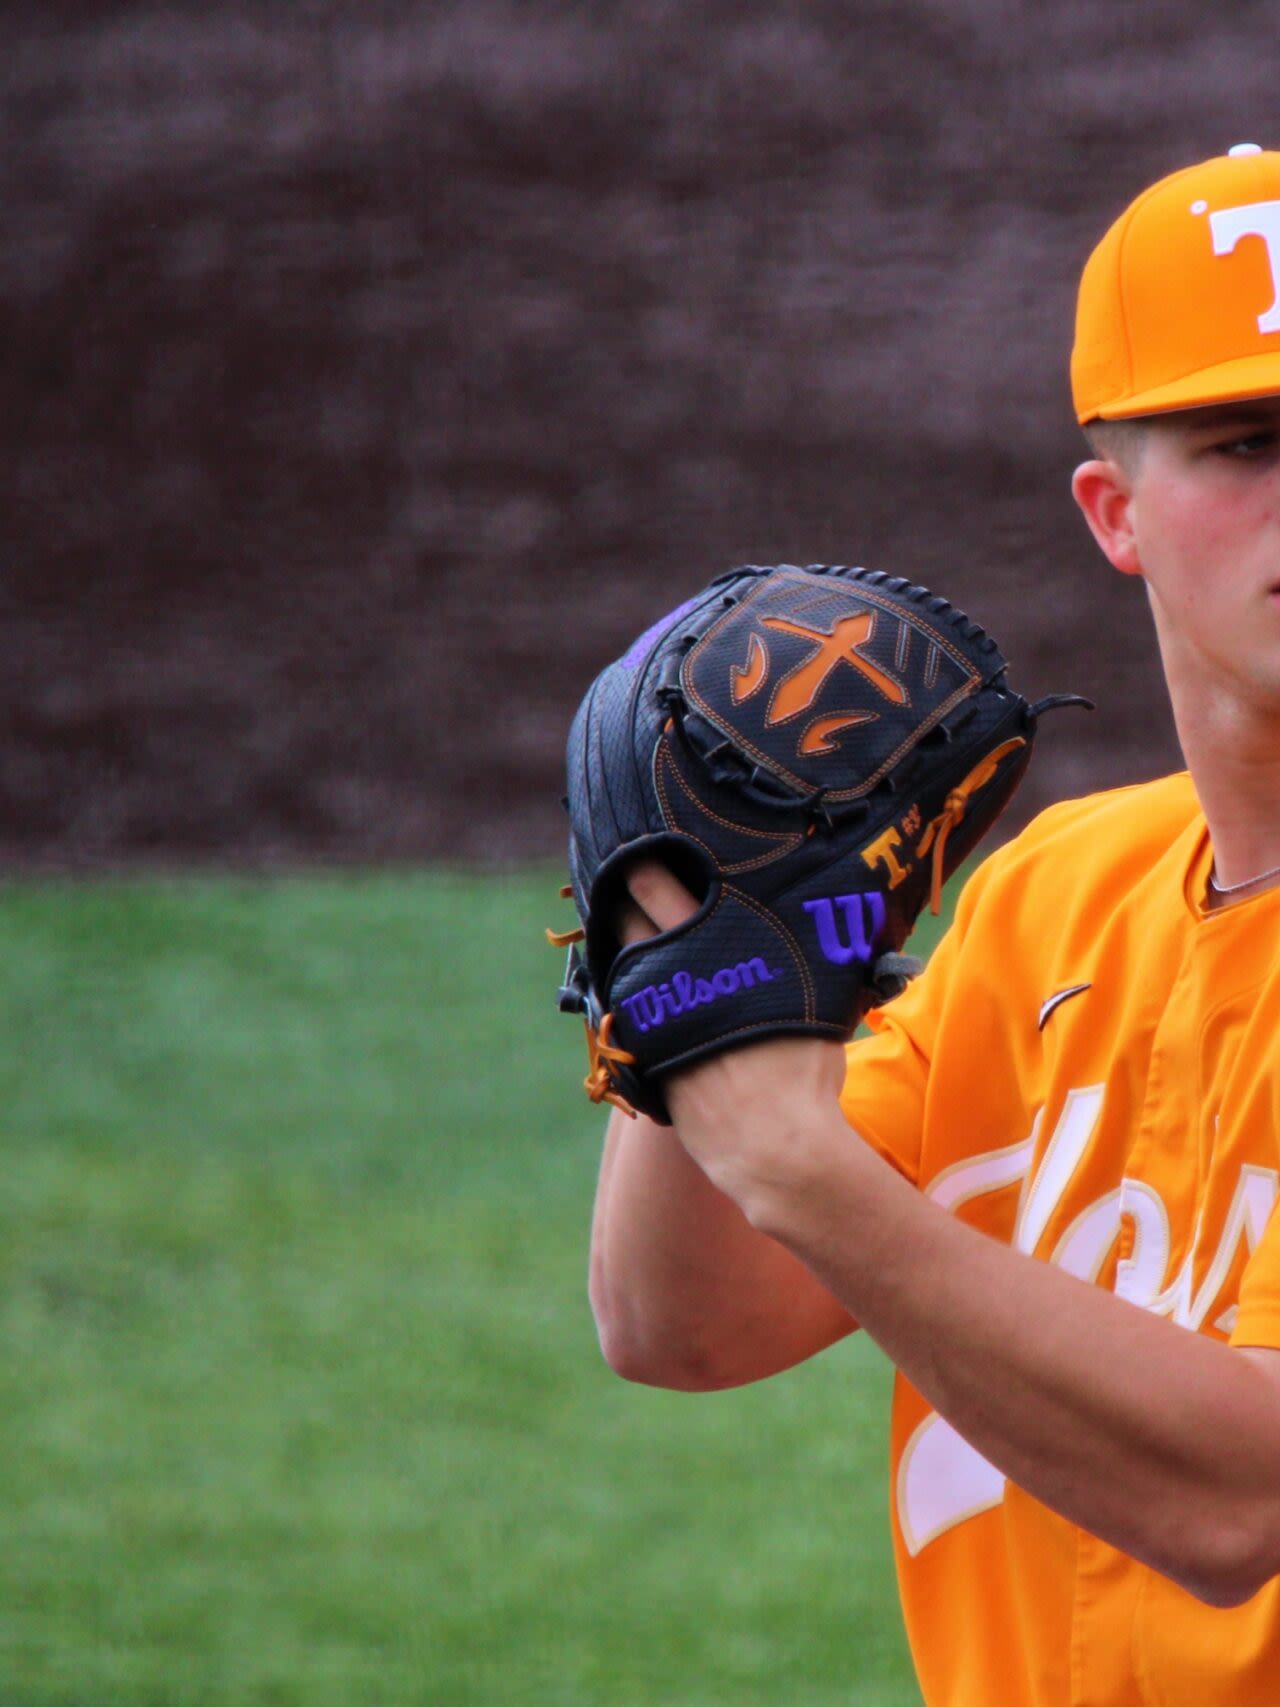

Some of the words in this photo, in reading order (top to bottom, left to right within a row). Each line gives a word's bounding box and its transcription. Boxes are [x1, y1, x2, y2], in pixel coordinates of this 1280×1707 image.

[860, 826, 903, 890] T
[802, 891, 886, 965] W
[621, 957, 775, 1033] Wilson
